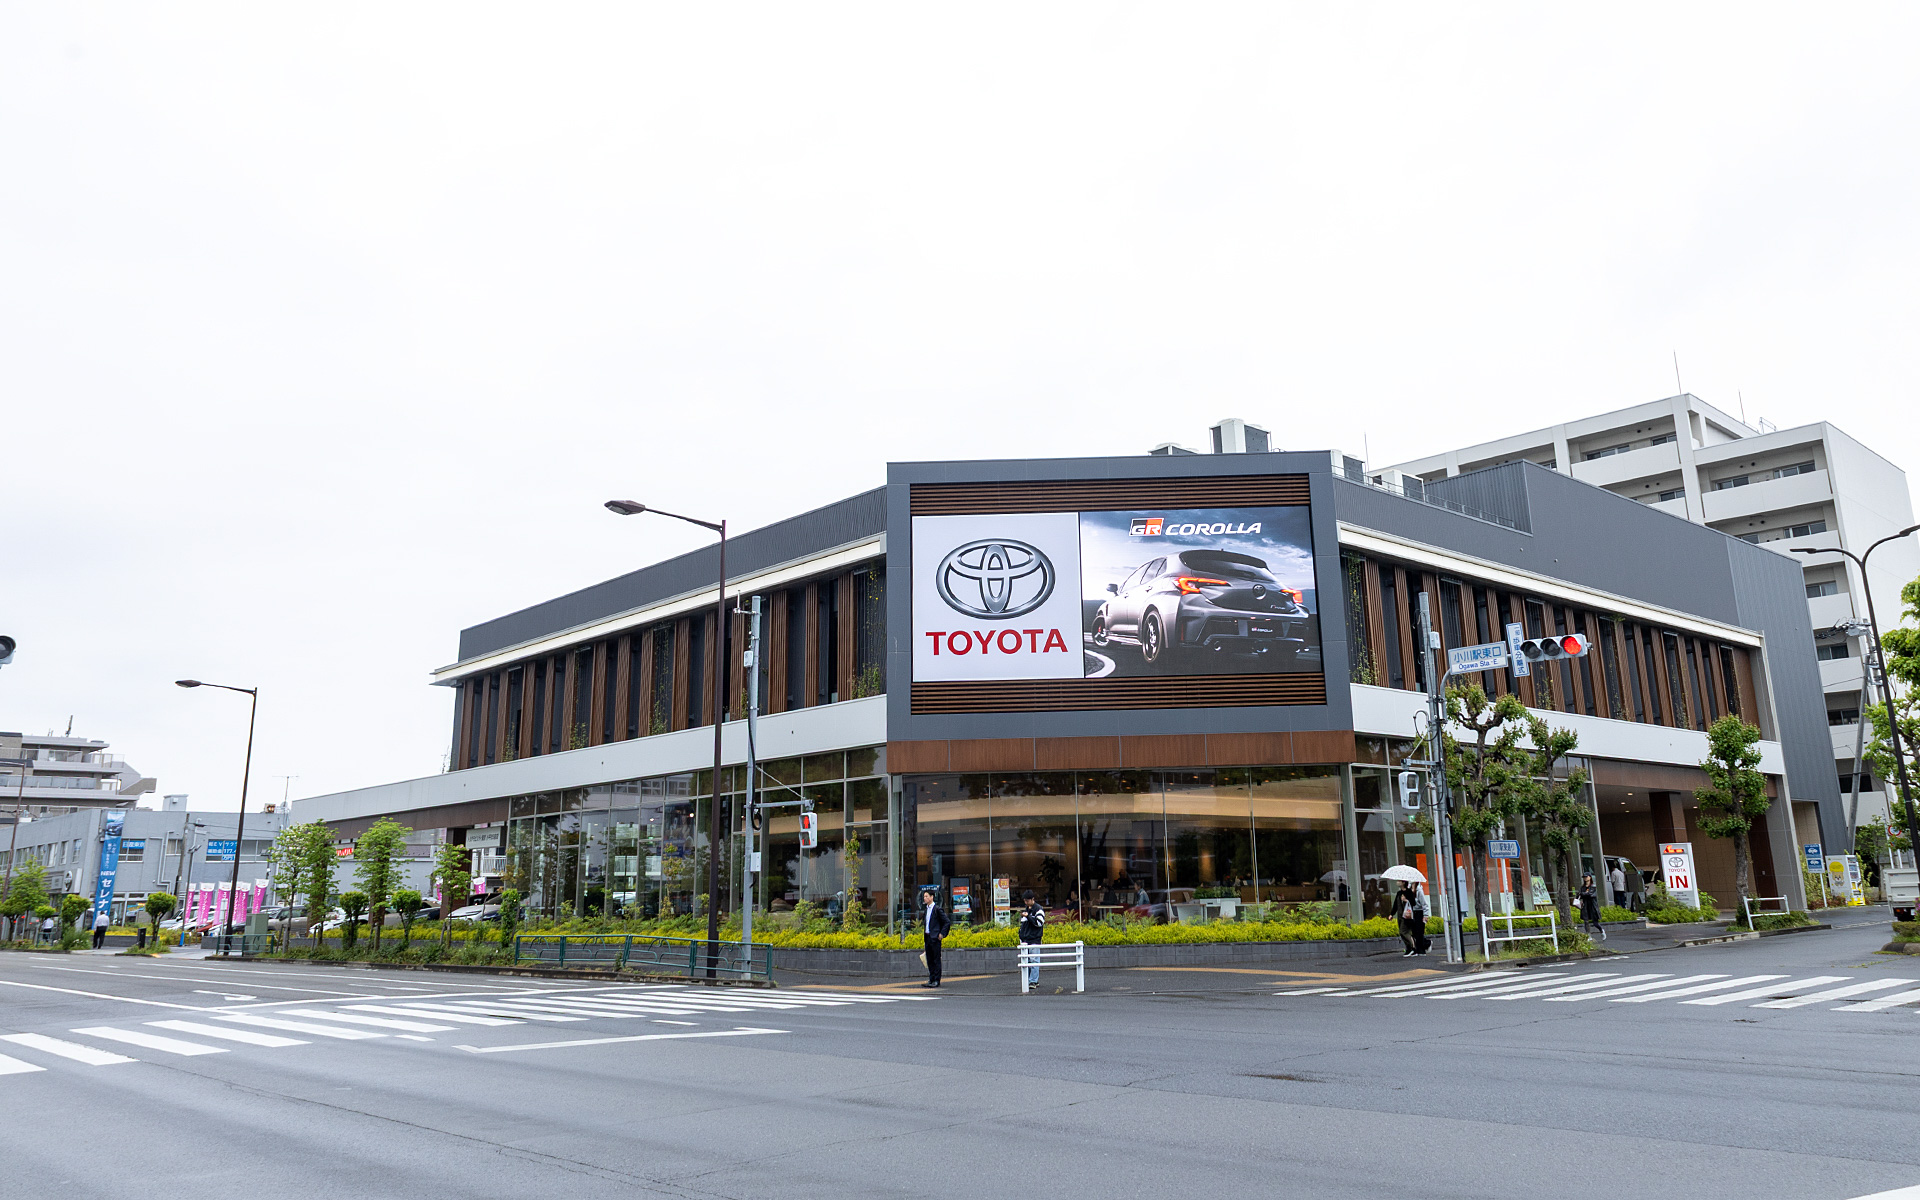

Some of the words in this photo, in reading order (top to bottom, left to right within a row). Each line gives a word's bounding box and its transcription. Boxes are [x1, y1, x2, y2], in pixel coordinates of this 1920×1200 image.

[1130, 521, 1162, 535] GR
[1165, 522, 1262, 536] COROLLA
[925, 628, 1069, 656] TOYOTA
[1454, 646, 1501, 663] 小川駅東口
[1459, 662, 1479, 671] Ogawa
[1669, 875, 1689, 889] IN
[98, 878, 112, 909] セレナ
